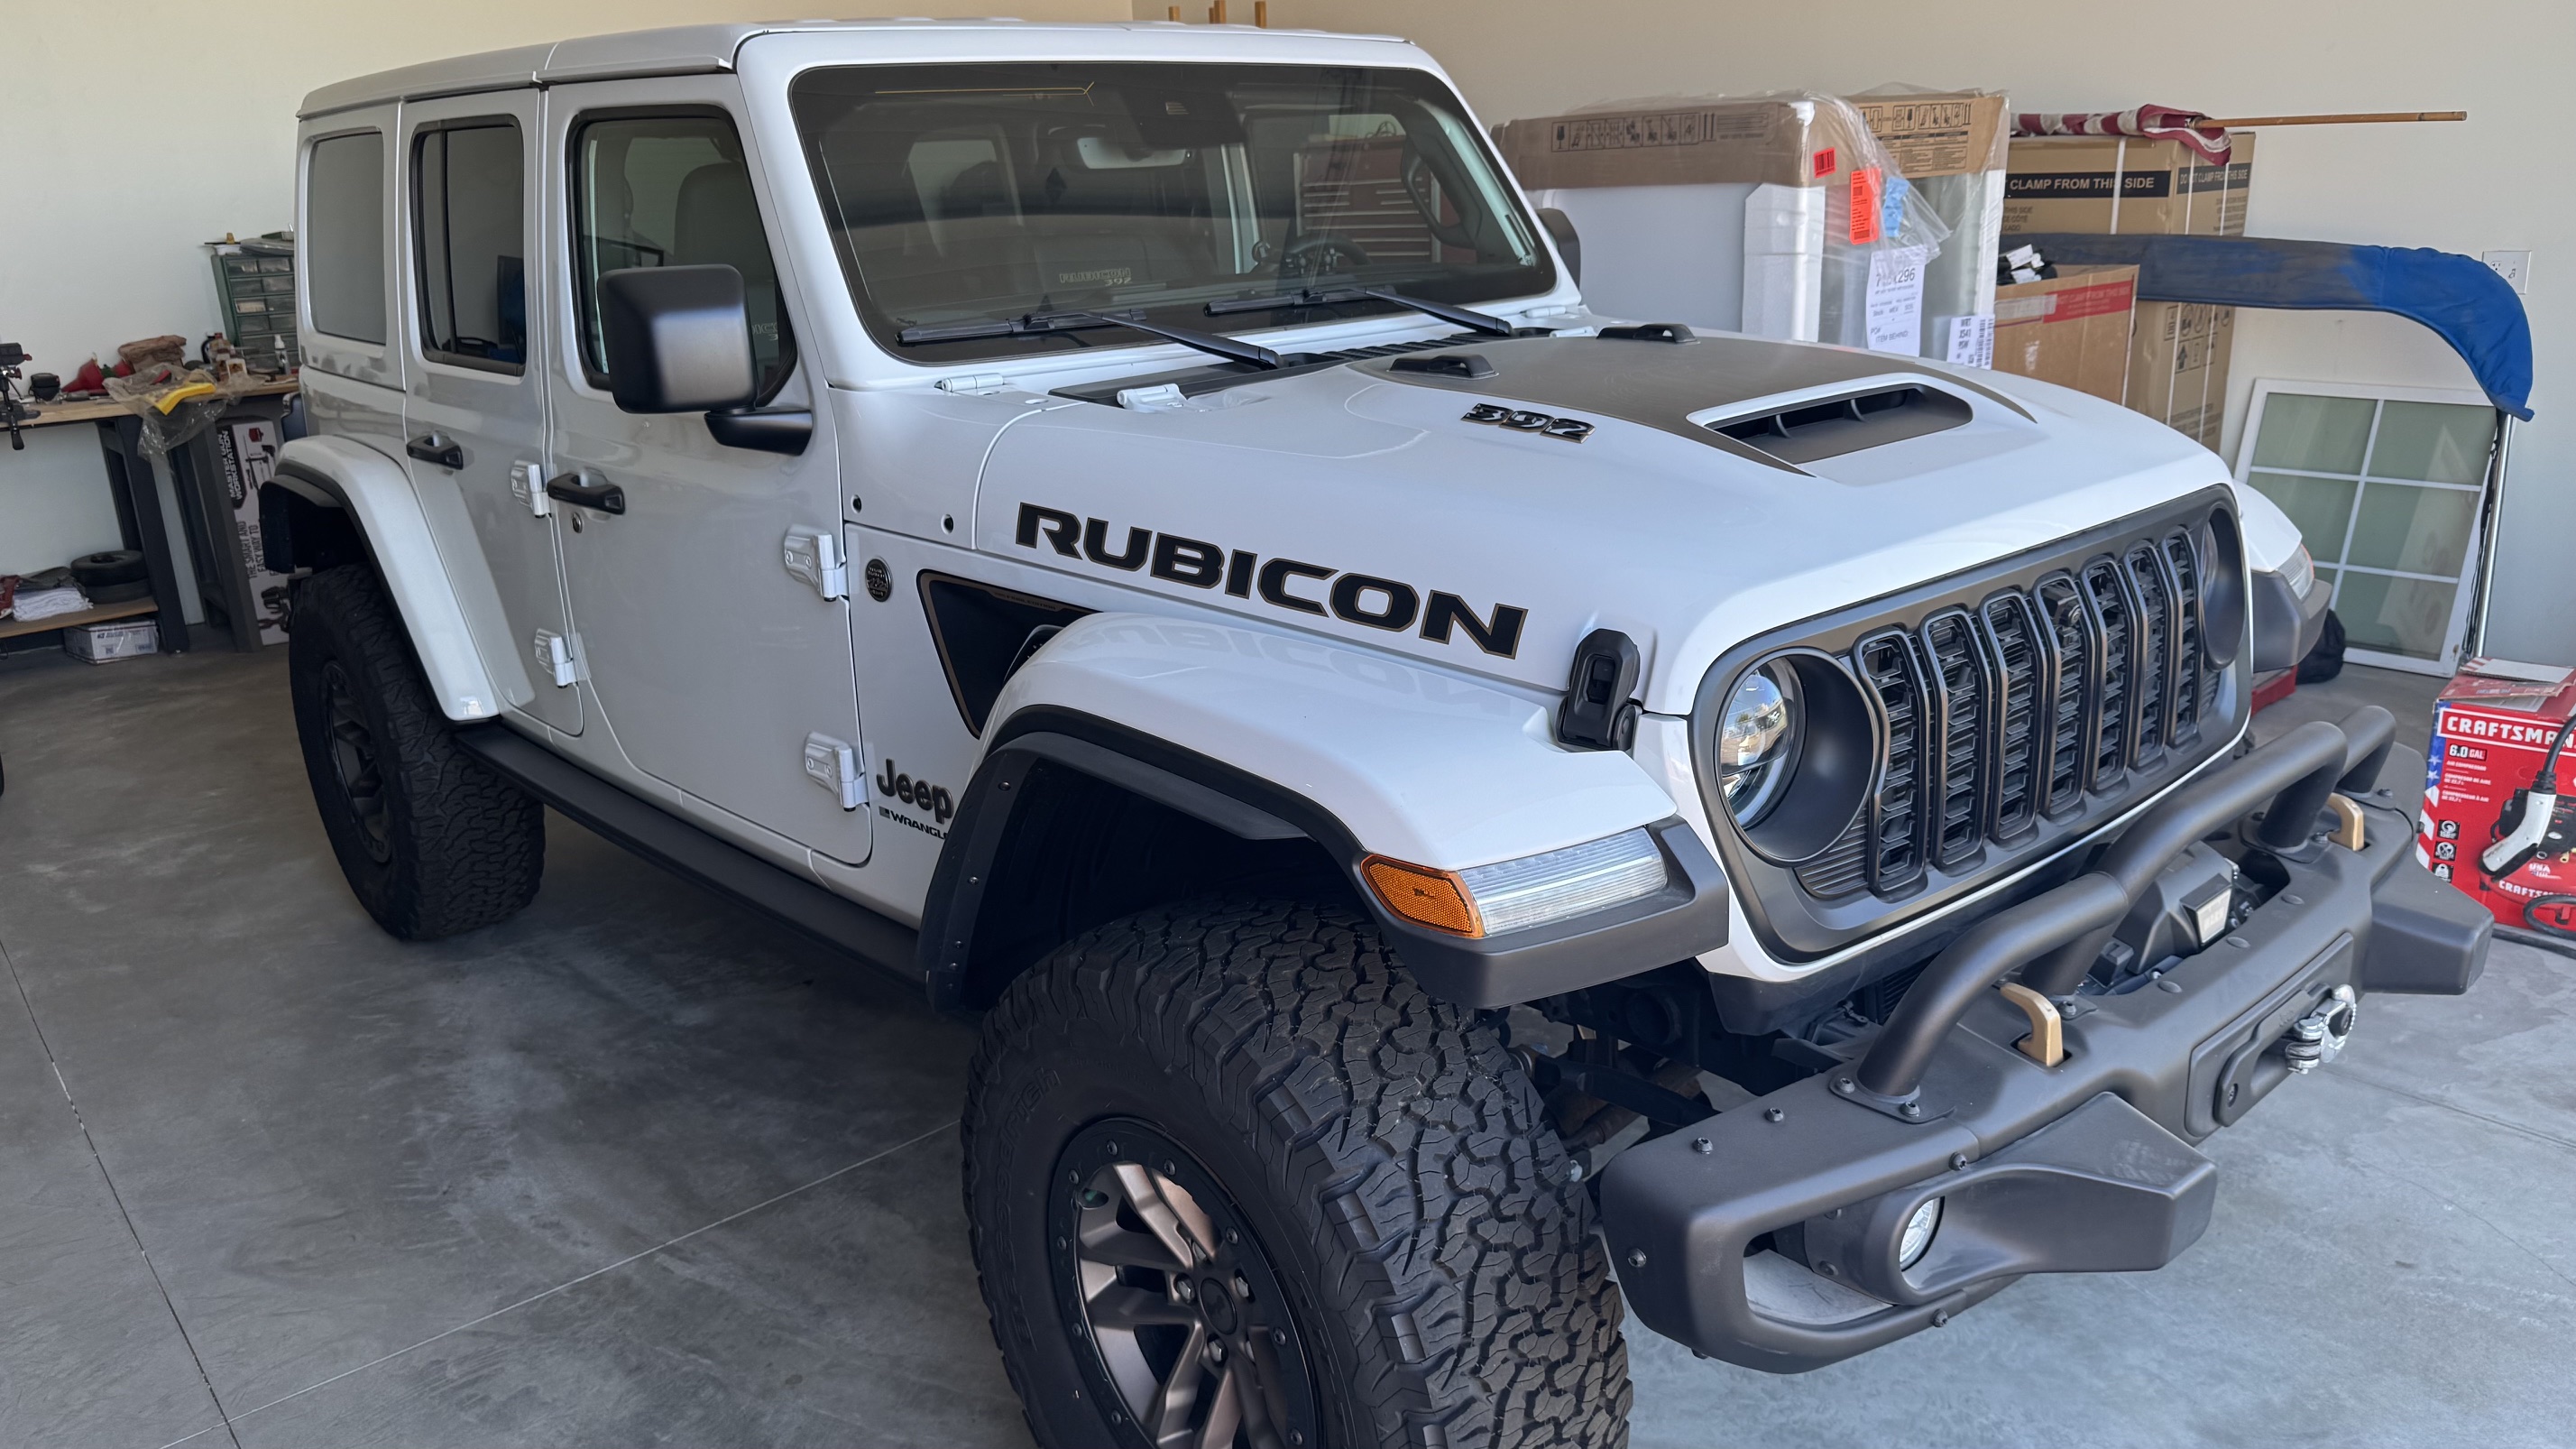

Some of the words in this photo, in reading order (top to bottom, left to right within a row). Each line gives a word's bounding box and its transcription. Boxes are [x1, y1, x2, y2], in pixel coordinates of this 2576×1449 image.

[2010, 179, 2052, 191] CLAMP
[2054, 178, 2090, 190] FROM
[2124, 177, 2155, 189] SIDE
[1059, 268, 1131, 283] RUBICON
[1104, 277, 1133, 287] 392
[1460, 402, 1596, 444] 392
[222, 429, 244, 500] WORKSTATION
[1016, 502, 1528, 660] RUBICON
[2447, 715, 2573, 749] CRAFTSMAN
[2449, 744, 2468, 759] 6.0
[2468, 749, 2485, 761] GAL
[876, 758, 954, 825] Jeep
